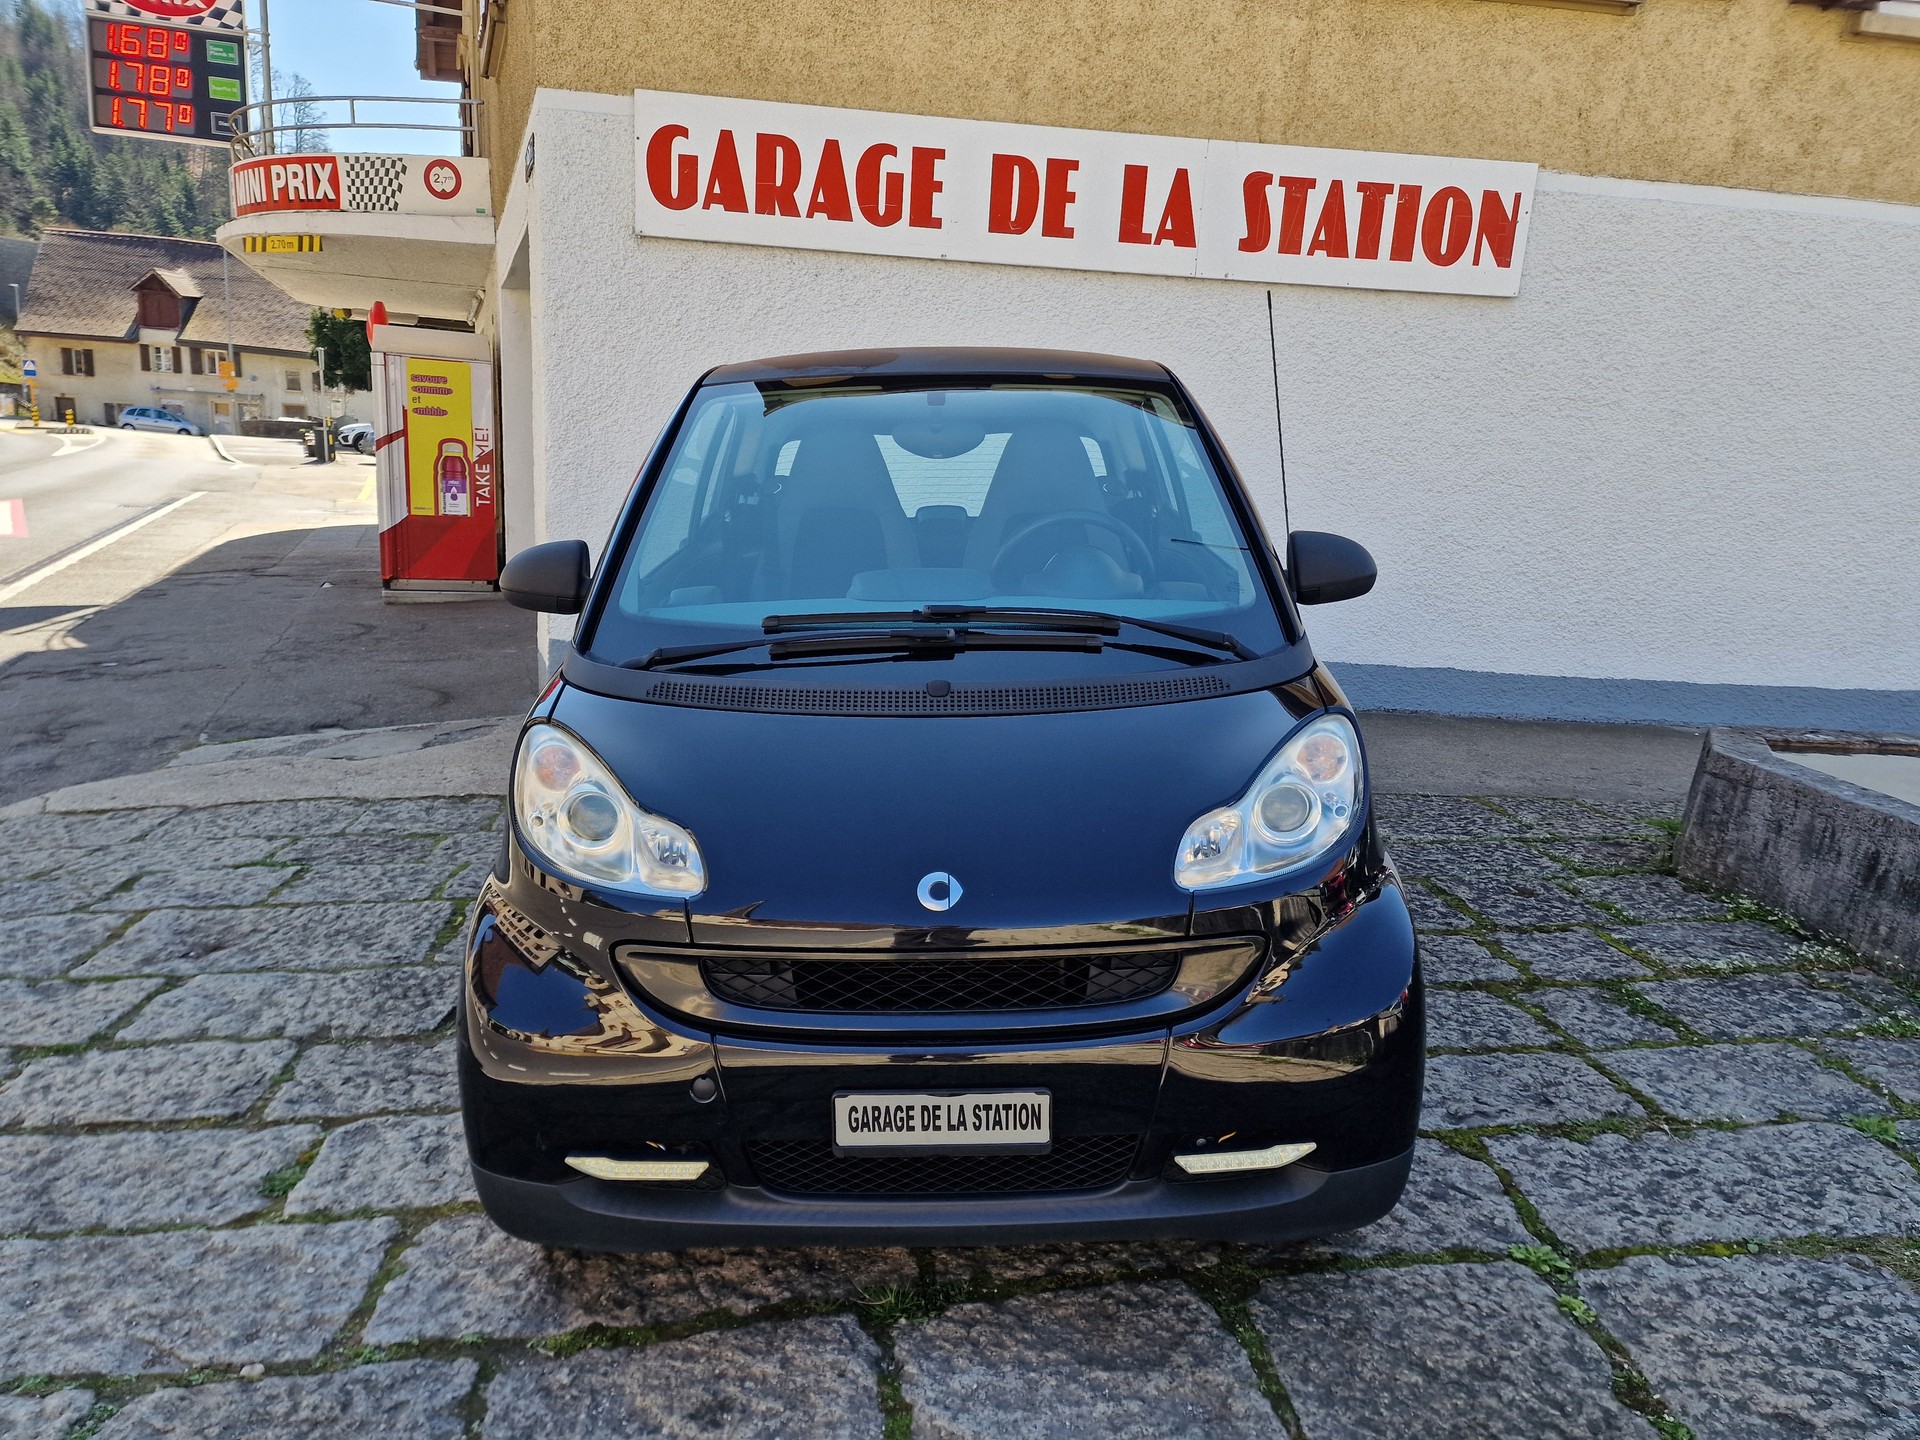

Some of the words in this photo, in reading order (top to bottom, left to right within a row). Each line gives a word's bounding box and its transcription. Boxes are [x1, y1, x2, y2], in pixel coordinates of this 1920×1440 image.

[270, 163, 336, 202] PRIX
[645, 123, 947, 229] GARAGE
[988, 153, 1079, 239] DE
[1119, 164, 1198, 248] LA
[1237, 170, 1522, 269] STATION
[410, 374, 448, 384] savoure
[474, 427, 489, 458] ME!
[475, 463, 491, 507] TAKE
[848, 1105, 915, 1133] GARAGE
[921, 1104, 942, 1131] DE
[946, 1104, 968, 1131] LA
[972, 1103, 1042, 1131] STATION
